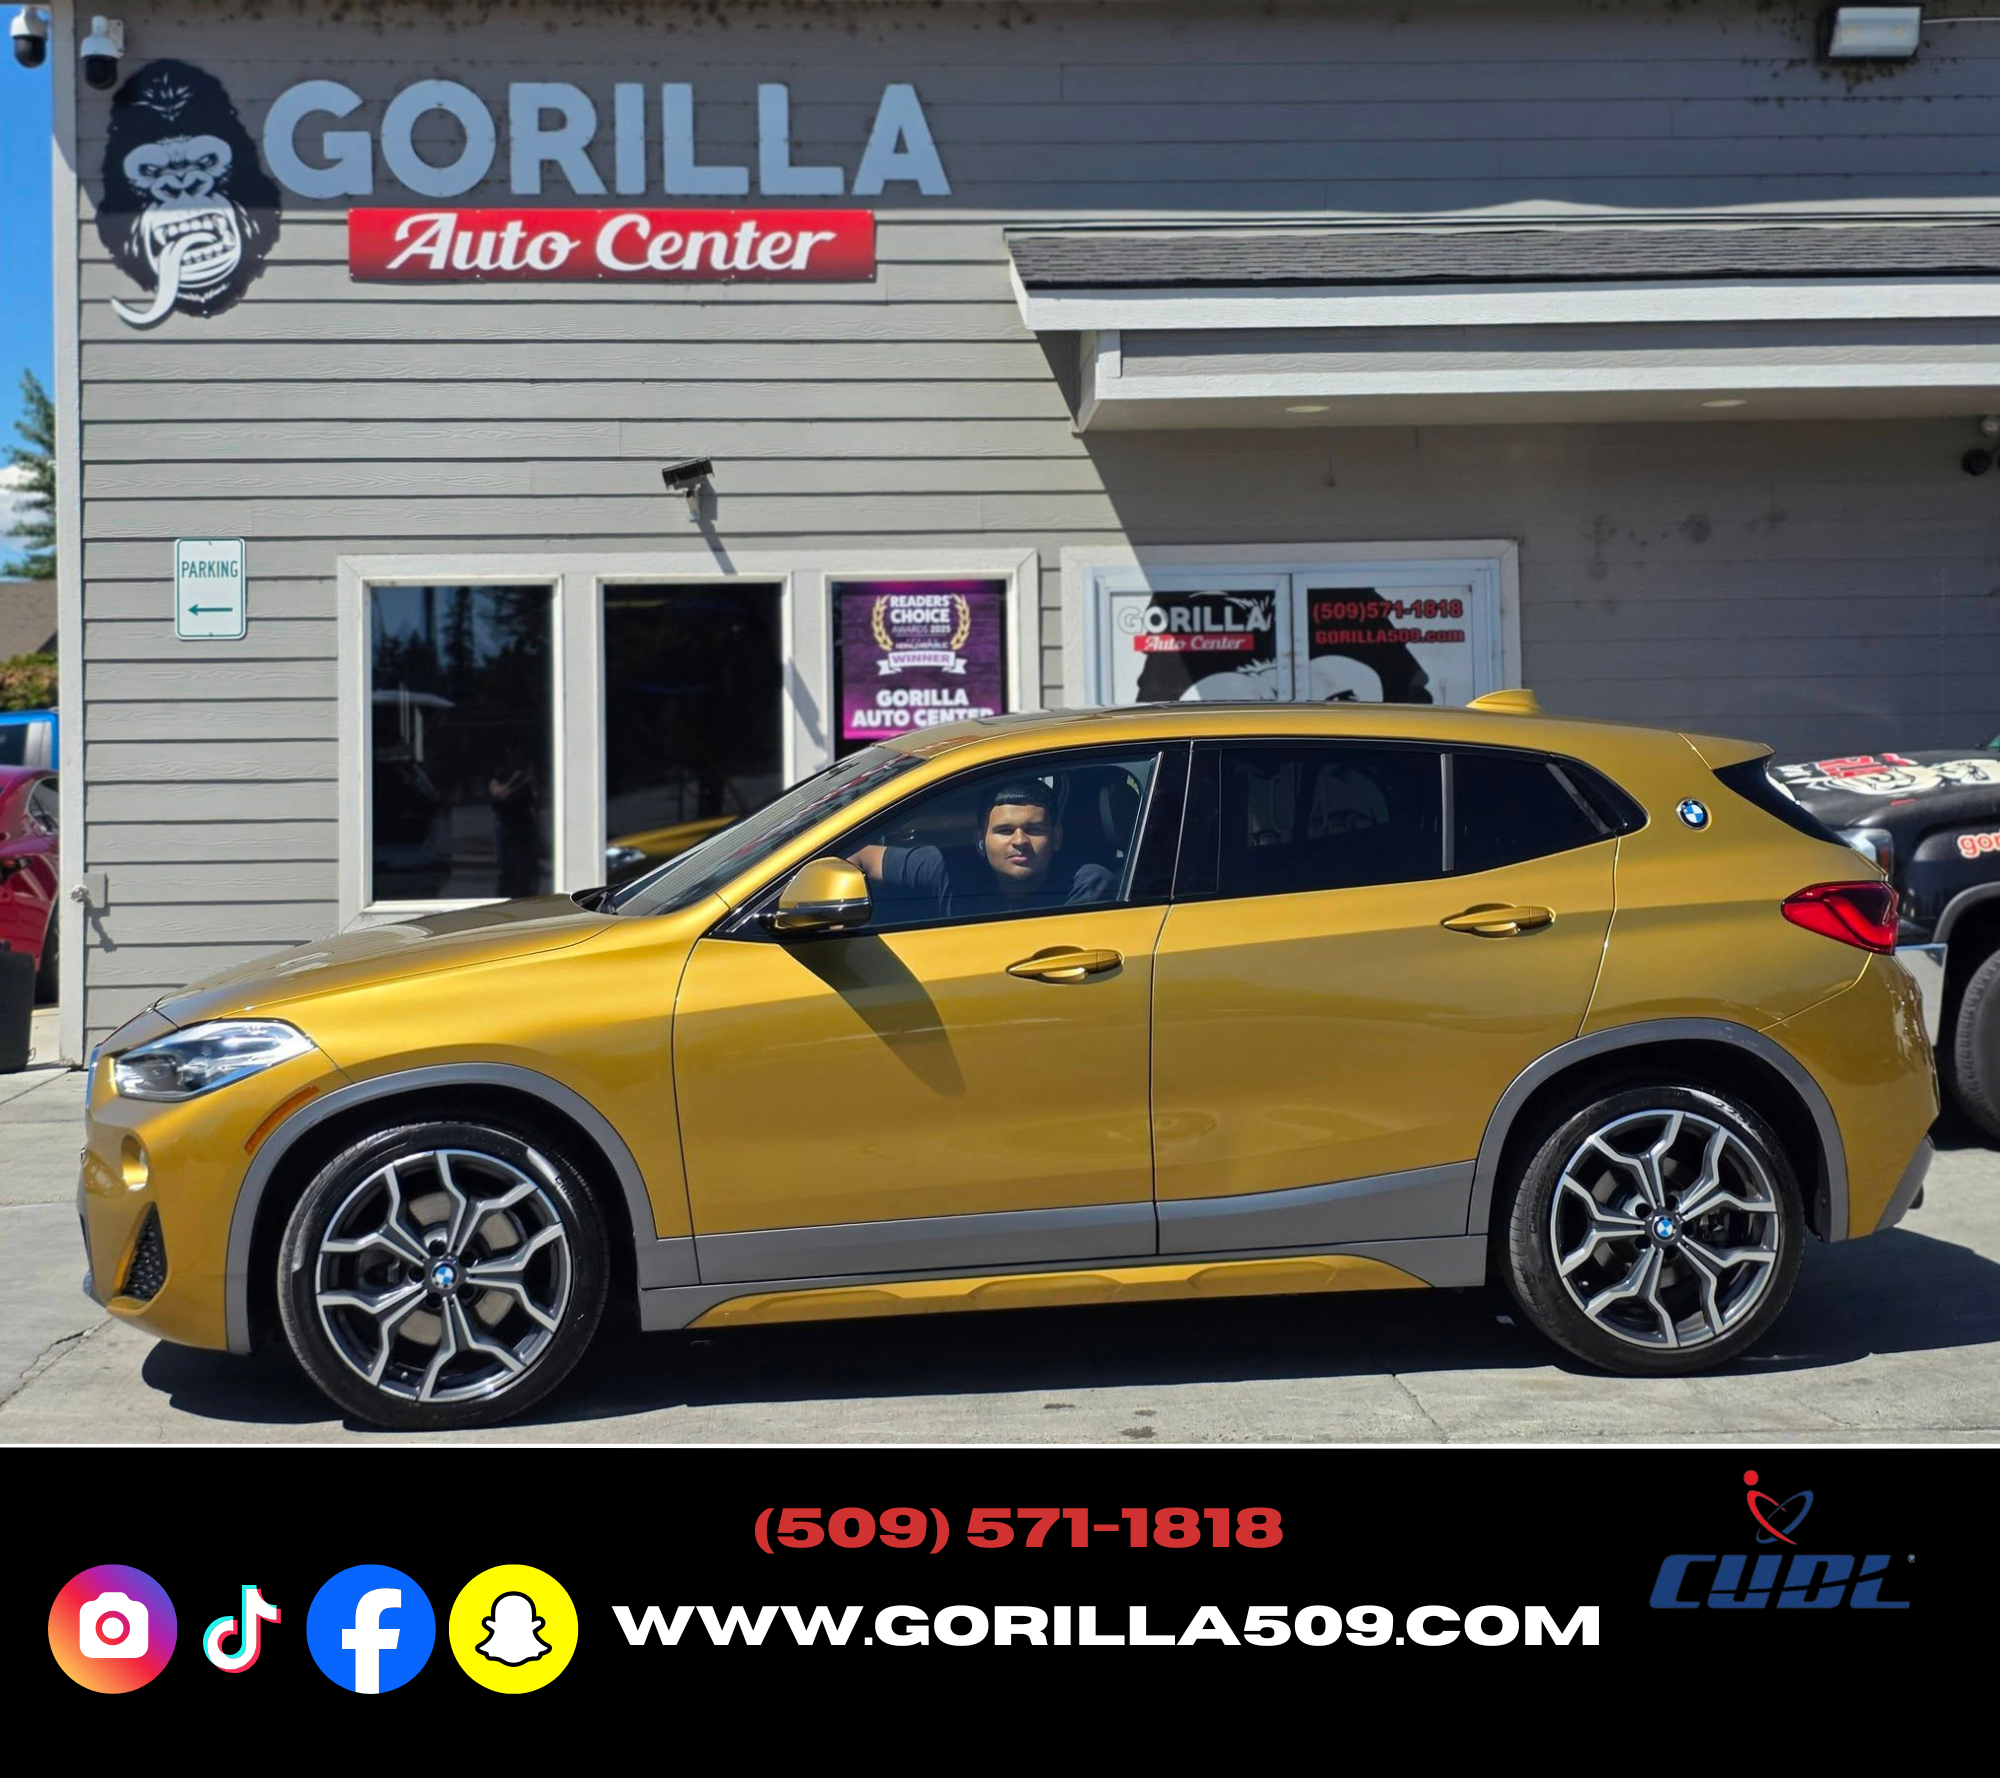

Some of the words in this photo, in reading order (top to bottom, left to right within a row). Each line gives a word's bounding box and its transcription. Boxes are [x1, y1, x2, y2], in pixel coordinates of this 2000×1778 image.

[263, 80, 951, 199] GORILLA
[386, 213, 581, 271] Auto
[595, 213, 837, 272] Center
[181, 560, 238, 578] PARKING
[890, 608, 950, 624] CHOICE
[1117, 605, 1269, 635] GORILLA
[1312, 599, 1464, 624] (509)571-1818
[891, 625, 928, 634] AWARDS
[930, 625, 951, 633] 2025
[1315, 628, 1466, 645] GORILLA509.com
[1143, 636, 1187, 650] Auto
[1190, 635, 1246, 650] Center
[892, 654, 950, 664] WINNER
[876, 688, 969, 707] GORILLA
[851, 709, 910, 728] AUTO
